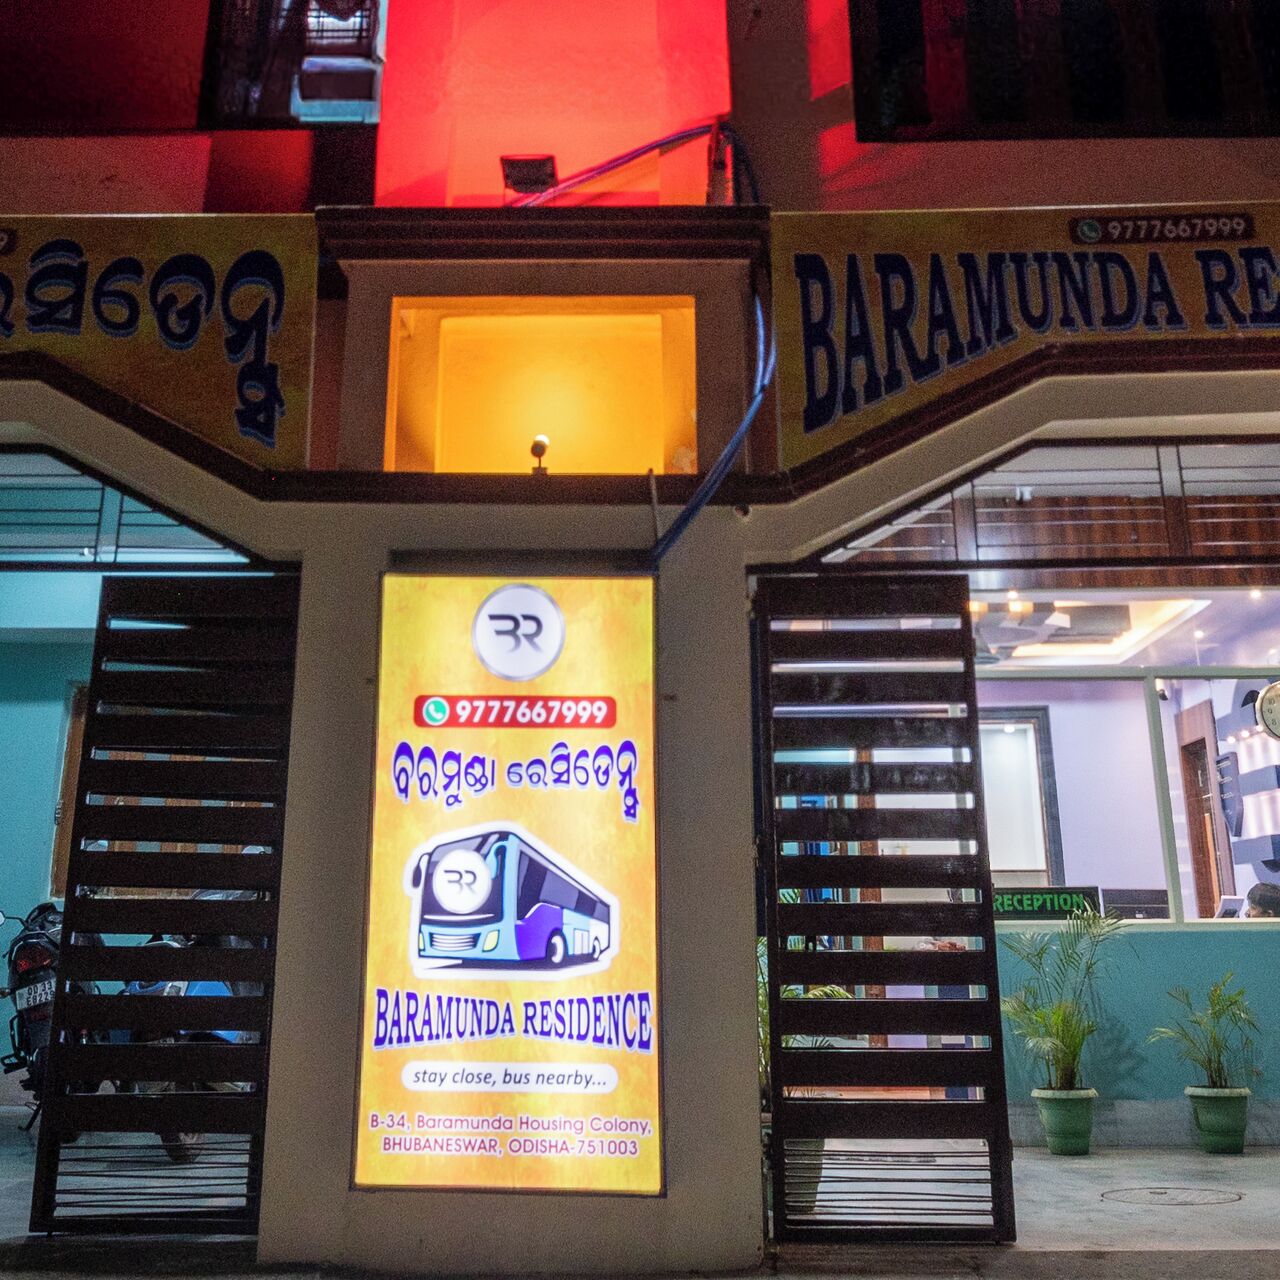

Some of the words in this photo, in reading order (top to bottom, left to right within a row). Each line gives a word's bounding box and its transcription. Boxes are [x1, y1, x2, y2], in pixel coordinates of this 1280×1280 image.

[1107, 217, 1246, 239] 9777667999
[793, 251, 1190, 436] BARAMUNDA
[456, 700, 608, 724] 9777667999
[993, 893, 1085, 912] RECEPTION
[373, 988, 515, 1047] BARAMUNDA
[522, 991, 652, 1051] RESIDENCE
[413, 1070, 447, 1086] stay
[452, 1069, 497, 1086] close,
[502, 1069, 531, 1085] bus
[535, 1070, 607, 1088] nearby...
[370, 1114, 410, 1130] B-34,
[417, 1114, 513, 1130] Baramunda
[519, 1115, 584, 1134] Housing
[590, 1116, 652, 1136] Colony,
[382, 1137, 502, 1155] BHUBANESWAR,
[508, 1138, 638, 1155] ODISHA-751003
